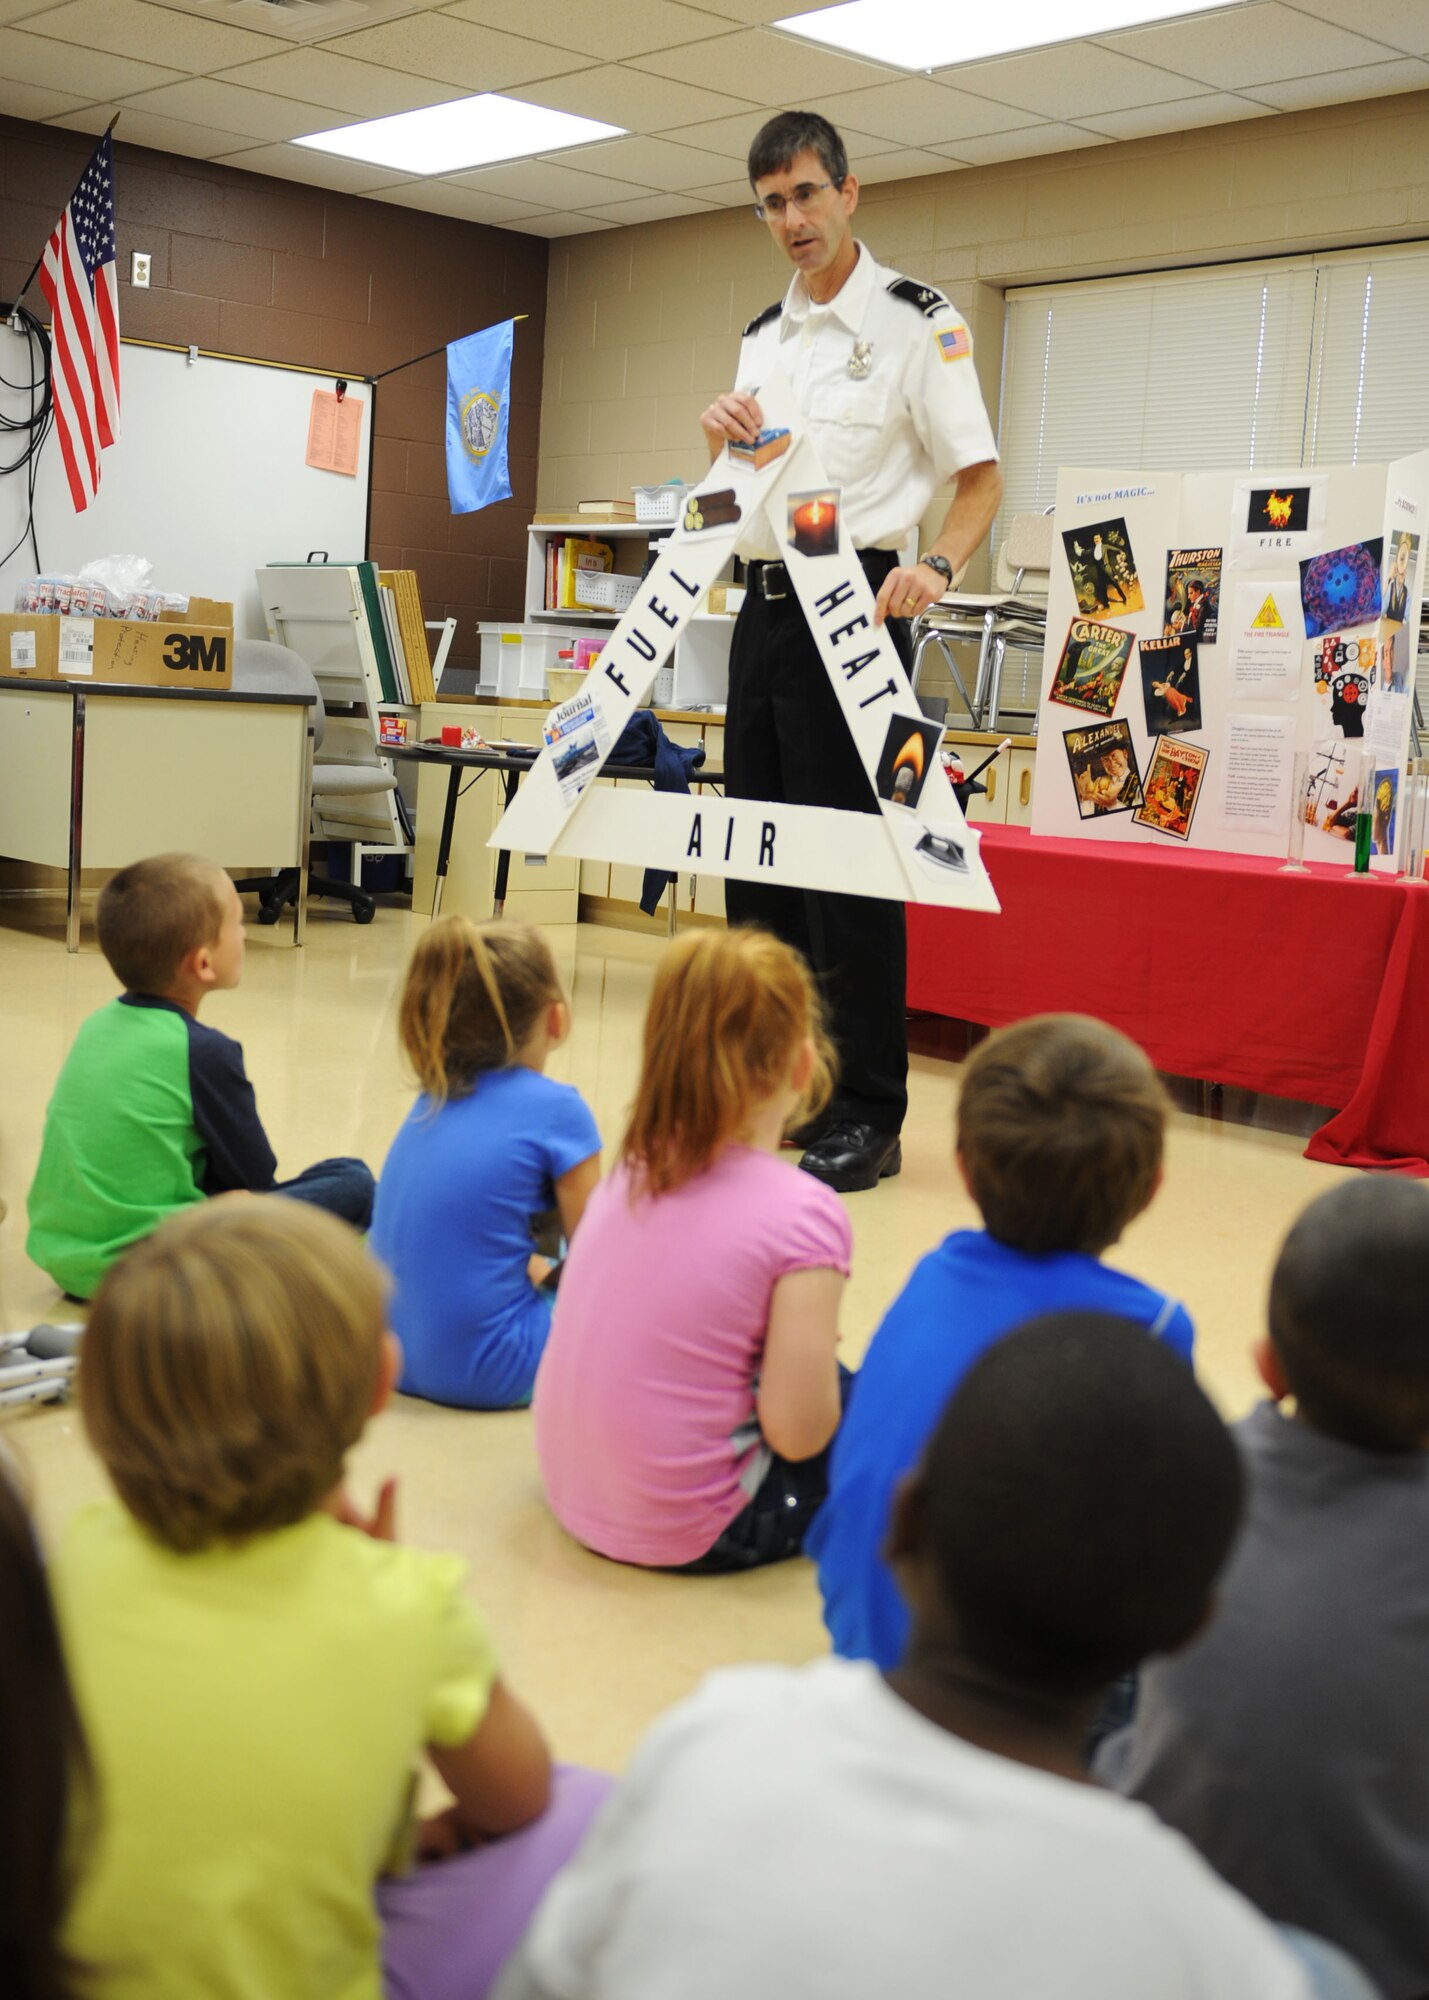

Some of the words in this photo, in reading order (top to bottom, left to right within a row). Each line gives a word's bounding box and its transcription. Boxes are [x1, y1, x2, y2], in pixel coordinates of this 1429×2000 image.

[1076, 495, 1093, 504] It's
[1095, 493, 1112, 502] not
[1259, 537, 1292, 547] FIRE
[1168, 549, 1221, 568] THURSTON
[604, 568, 700, 697] FUEL
[815, 579, 899, 709] HEAT
[1071, 620, 1124, 647] CARTER
[1140, 637, 1181, 651] KELLAR
[162, 633, 227, 672] 3M
[1088, 645, 1110, 657] GREAT
[1095, 641, 1107, 650] THE
[556, 693, 593, 723] Journal
[687, 813, 776, 866] AIR
